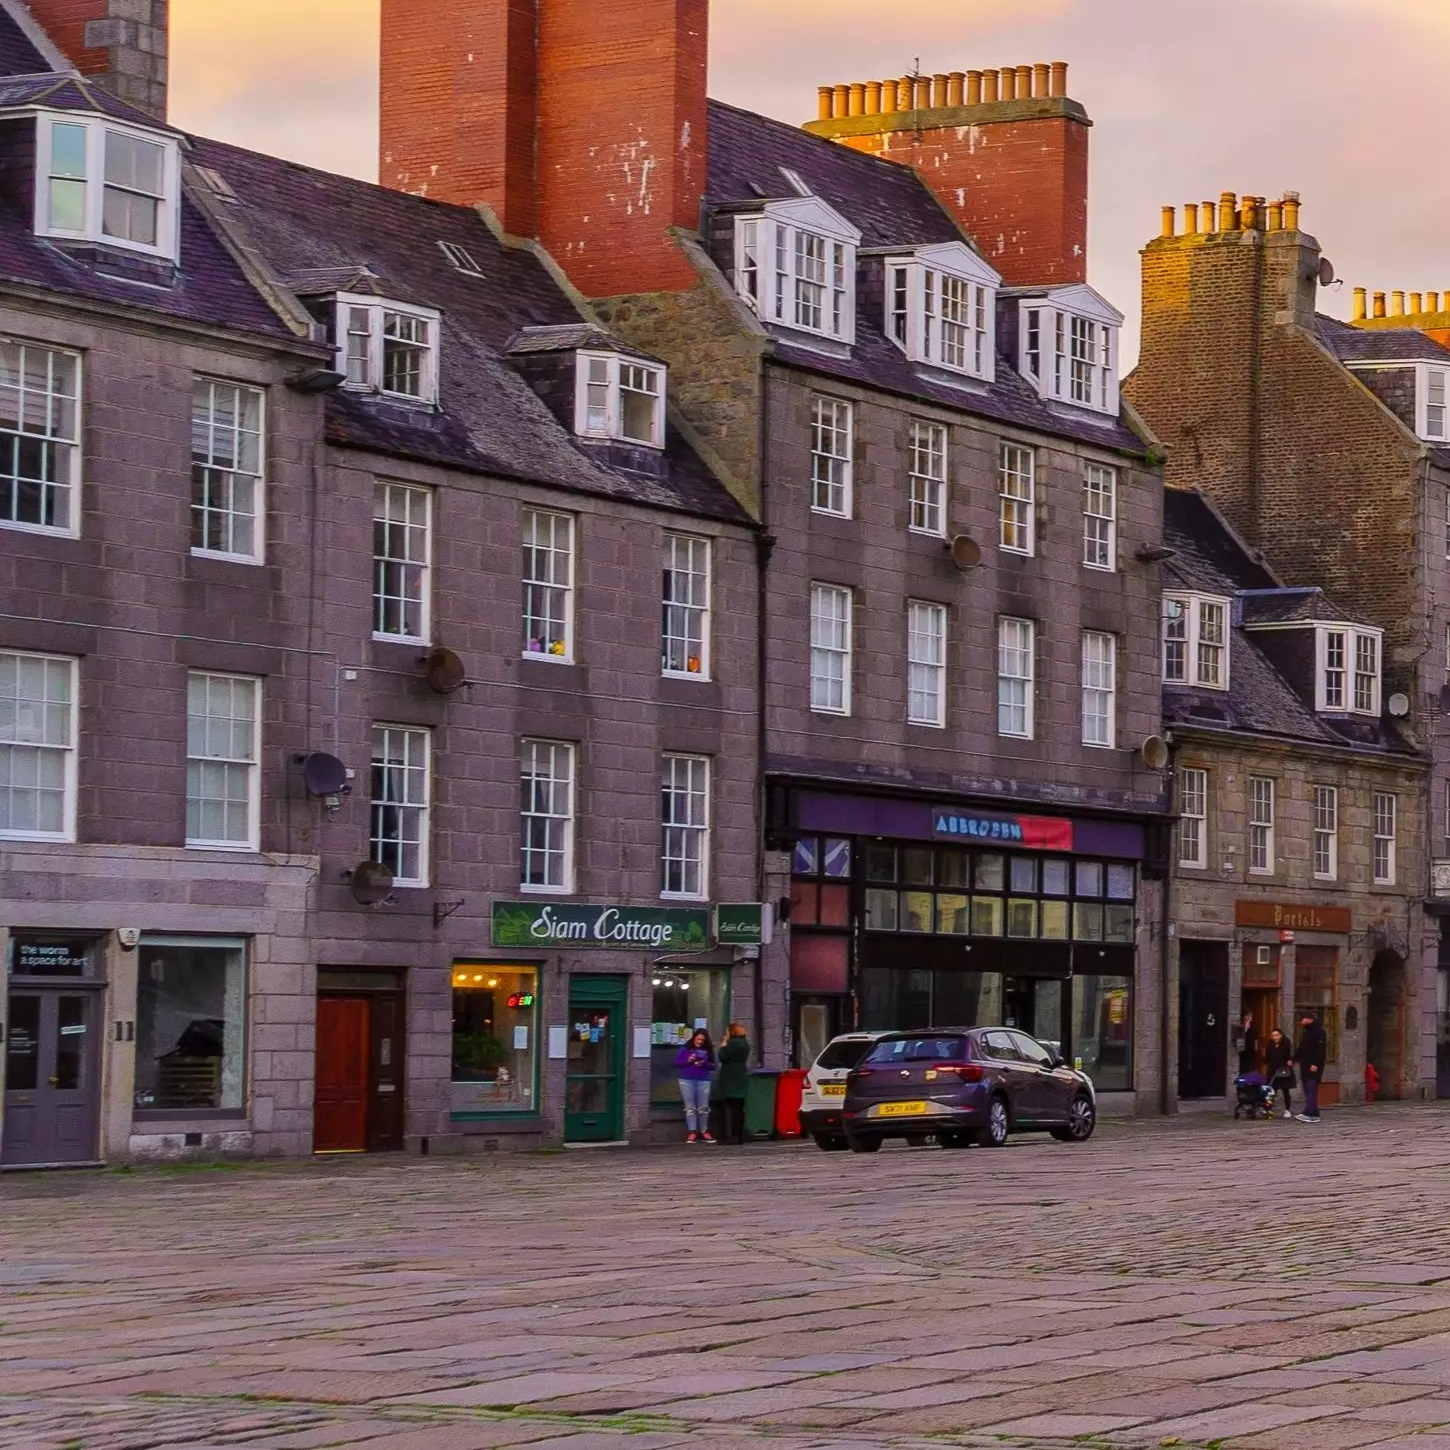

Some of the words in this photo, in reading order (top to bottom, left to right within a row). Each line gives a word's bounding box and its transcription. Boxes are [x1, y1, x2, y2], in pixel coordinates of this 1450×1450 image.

[1274, 904, 1321, 926] Portals
[530, 906, 587, 939] Siam
[594, 908, 673, 945] Cottage
[21, 944, 38, 954] the
[39, 947, 69, 955] worm
[20, 957, 27, 965] a
[28, 957, 57, 966] space
[58, 955, 71, 965] for
[72, 957, 88, 966] art
[113, 1021, 134, 1041] 11
